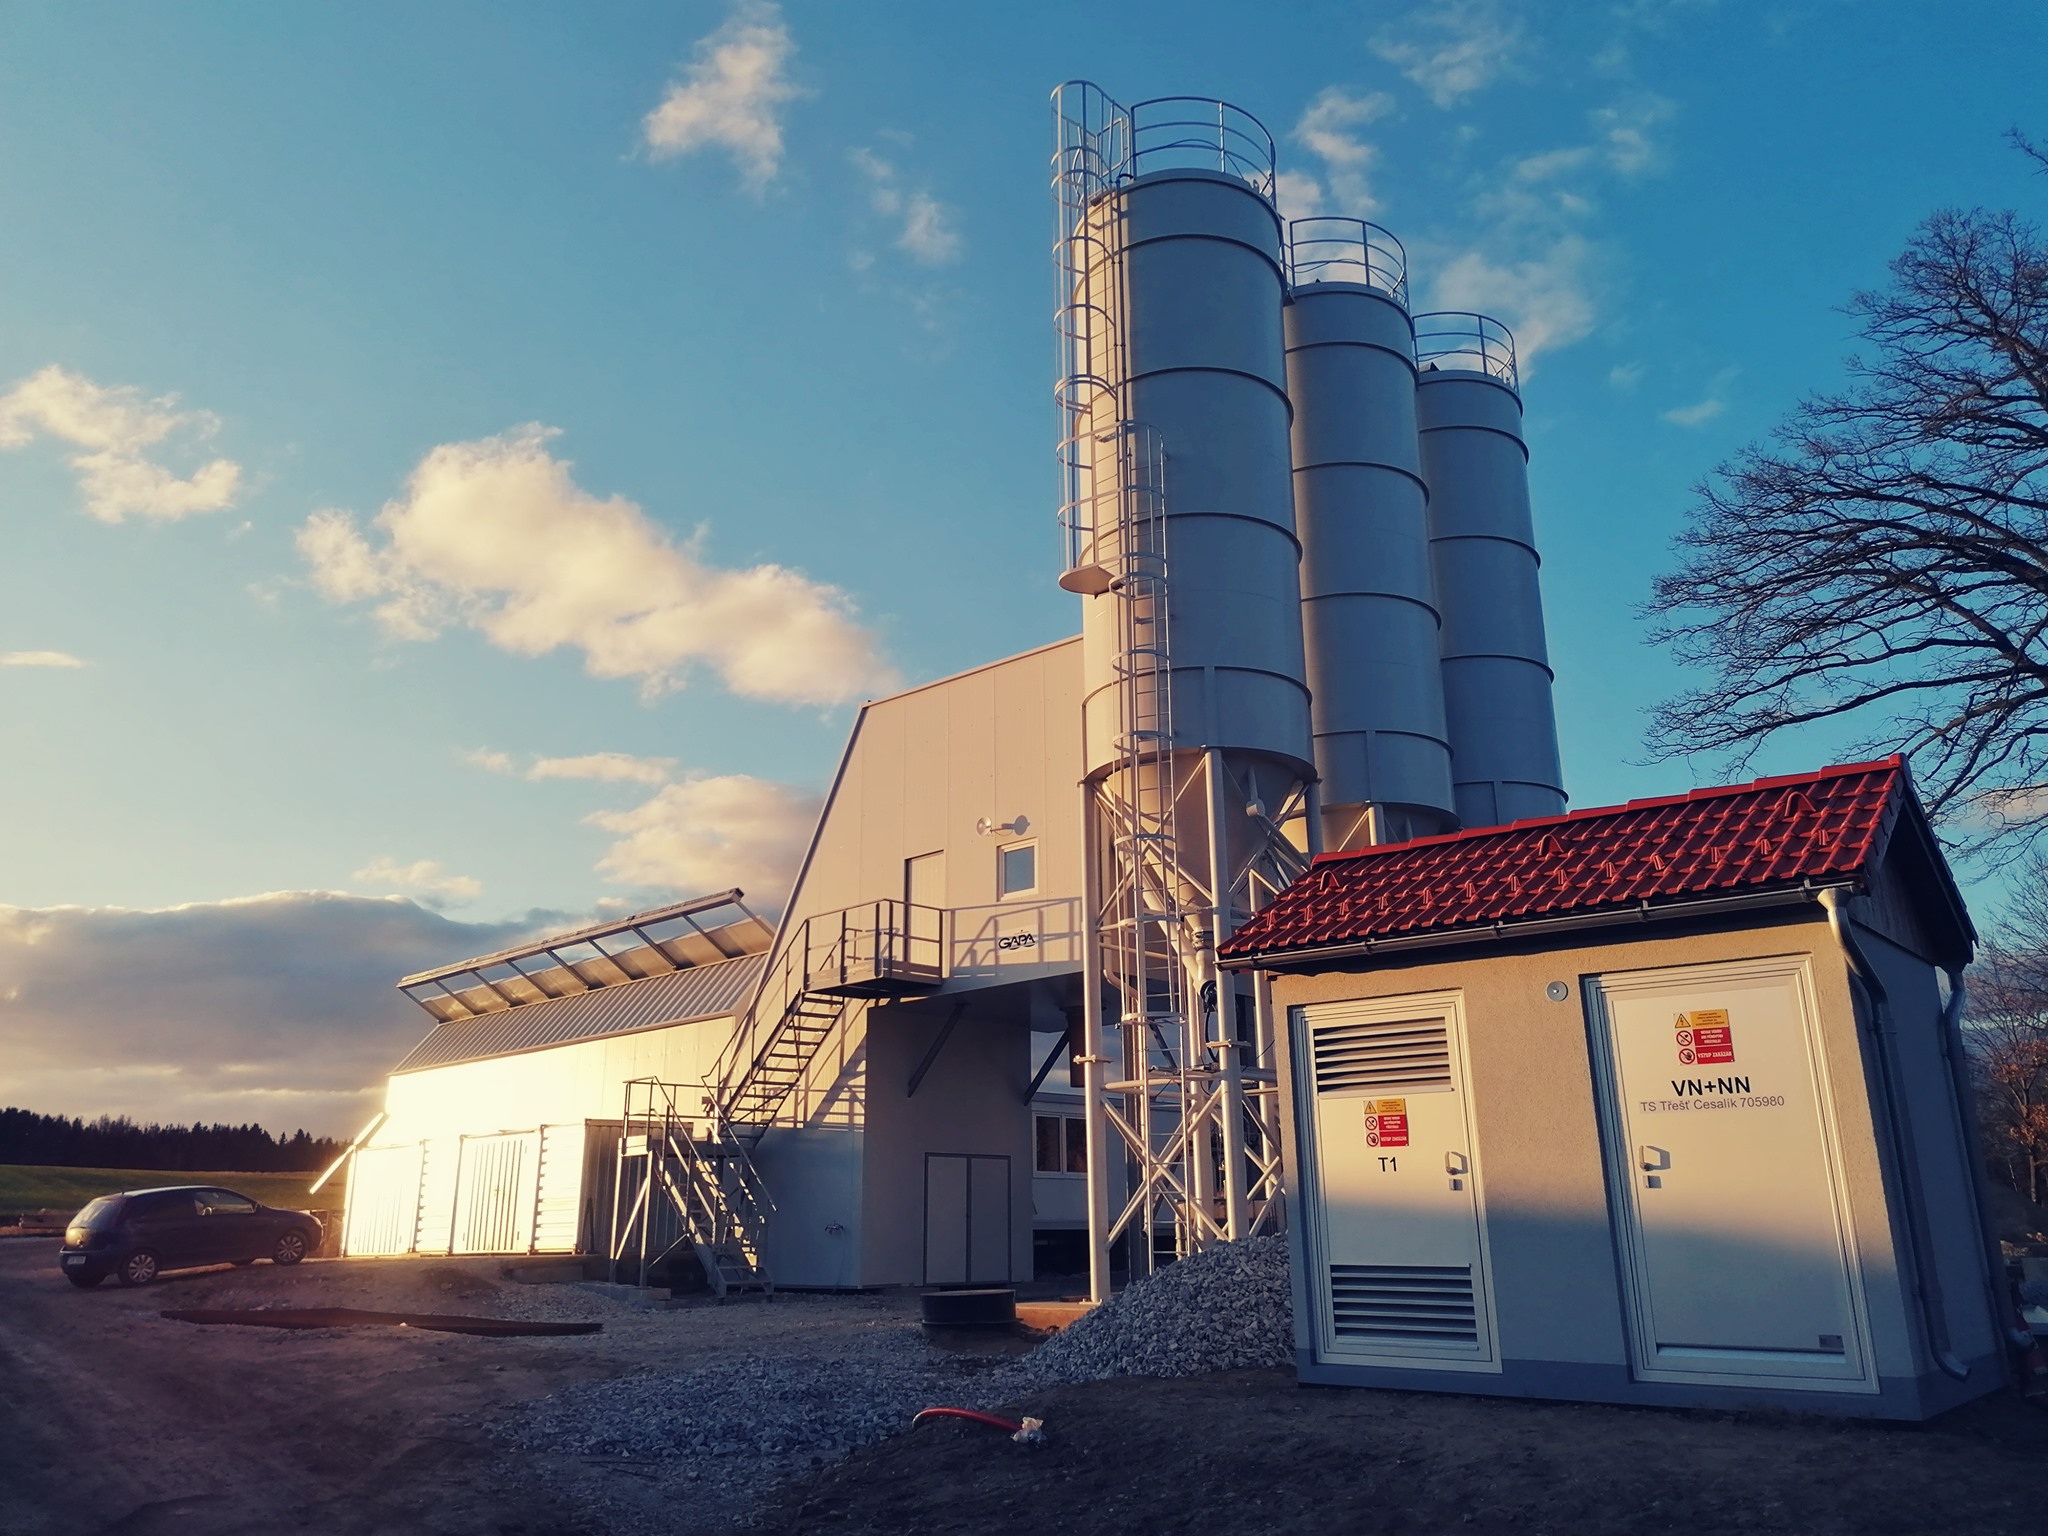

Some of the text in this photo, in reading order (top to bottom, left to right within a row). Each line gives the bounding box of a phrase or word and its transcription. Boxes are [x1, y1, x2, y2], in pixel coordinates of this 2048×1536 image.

[998, 933, 1036, 950] GAPA
[1671, 1076, 1751, 1097] VN+NN
[1640, 1101, 1657, 1112] TS
[1660, 1099, 1690, 1111] Třešť
[1739, 1095, 1785, 1108] 705980
[1378, 1157, 1397, 1172] T1
